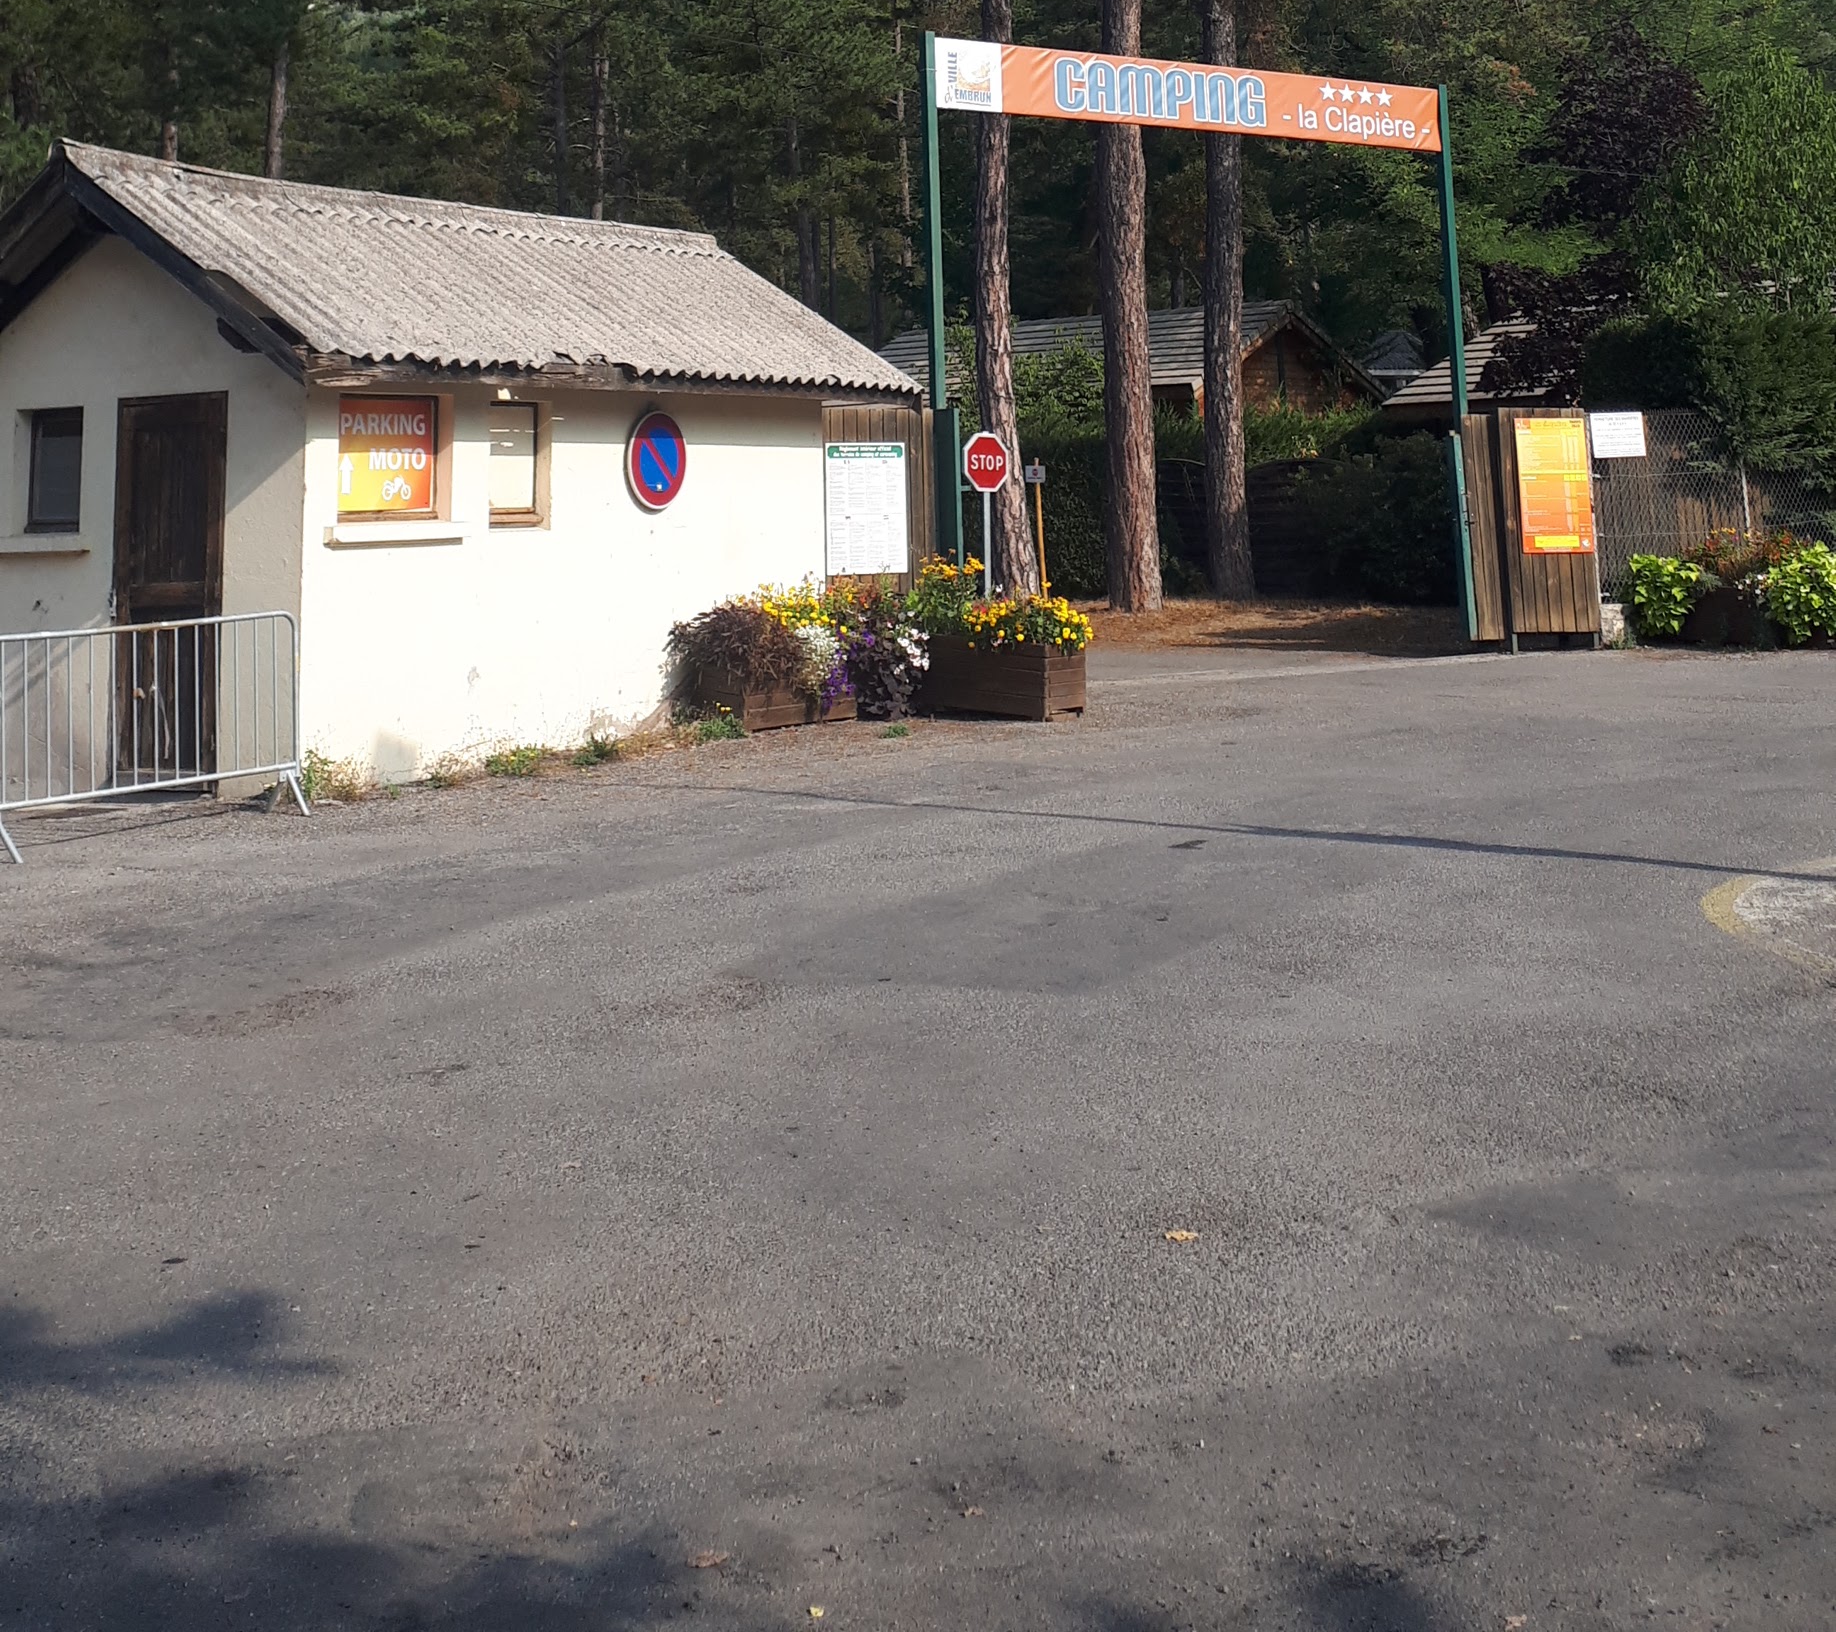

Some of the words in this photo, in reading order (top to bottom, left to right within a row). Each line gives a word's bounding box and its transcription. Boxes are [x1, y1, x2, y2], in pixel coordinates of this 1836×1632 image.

[947, 52, 957, 83] VILLE
[1054, 57, 1267, 127] CAMPING
[1298, 103, 1318, 130] la
[1324, 106, 1416, 140] Clapière
[340, 413, 426, 436] PARKING
[369, 447, 426, 470] MOTO
[970, 453, 1004, 471] STOP
